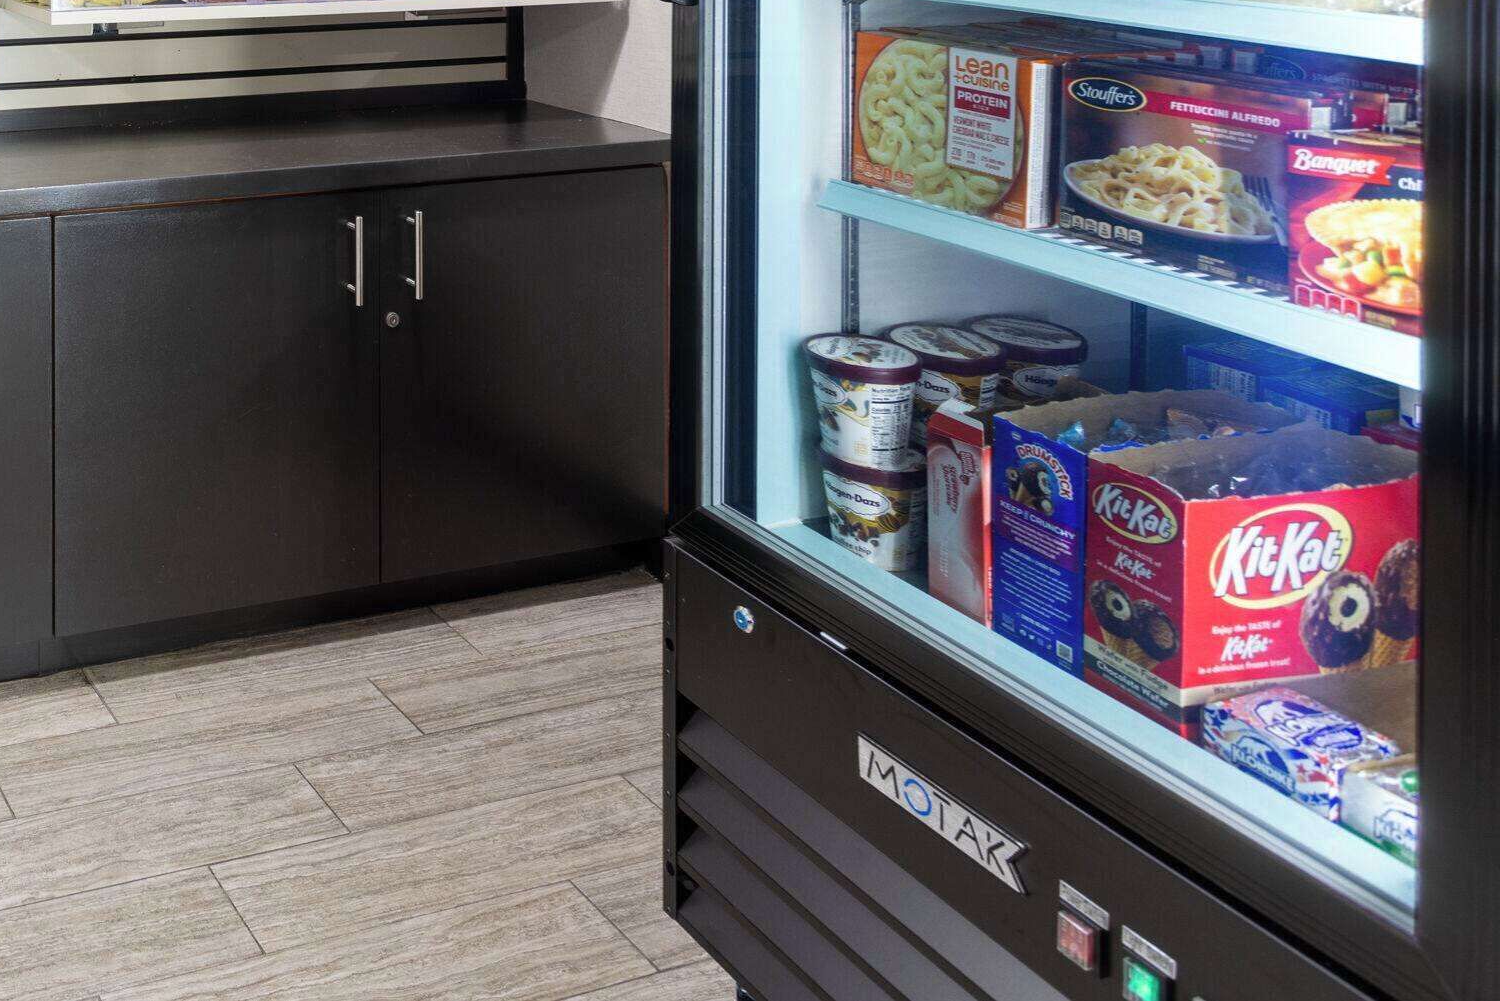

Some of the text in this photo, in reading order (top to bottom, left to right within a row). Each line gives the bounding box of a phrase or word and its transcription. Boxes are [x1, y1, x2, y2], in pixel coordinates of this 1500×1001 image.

[955, 55, 1010, 81] Lean
[957, 90, 1009, 110] PROTEIN
[1076, 81, 1138, 107] Stouffer's
[1169, 100, 1281, 129] FETTUCCINI ALFREDO
[1293, 148, 1380, 176] Banquet
[1015, 442, 1074, 501] DRUMSTICK
[1028, 513, 1077, 540] CRUNCHY
[1211, 619, 1282, 636] Enjoy the TASTE of
[1213, 662, 1245, 674] delicious
[1245, 659, 1269, 669] frozen
[1231, 743, 1296, 795] KLONDIKE
[866, 750, 1006, 877] MOTAK
